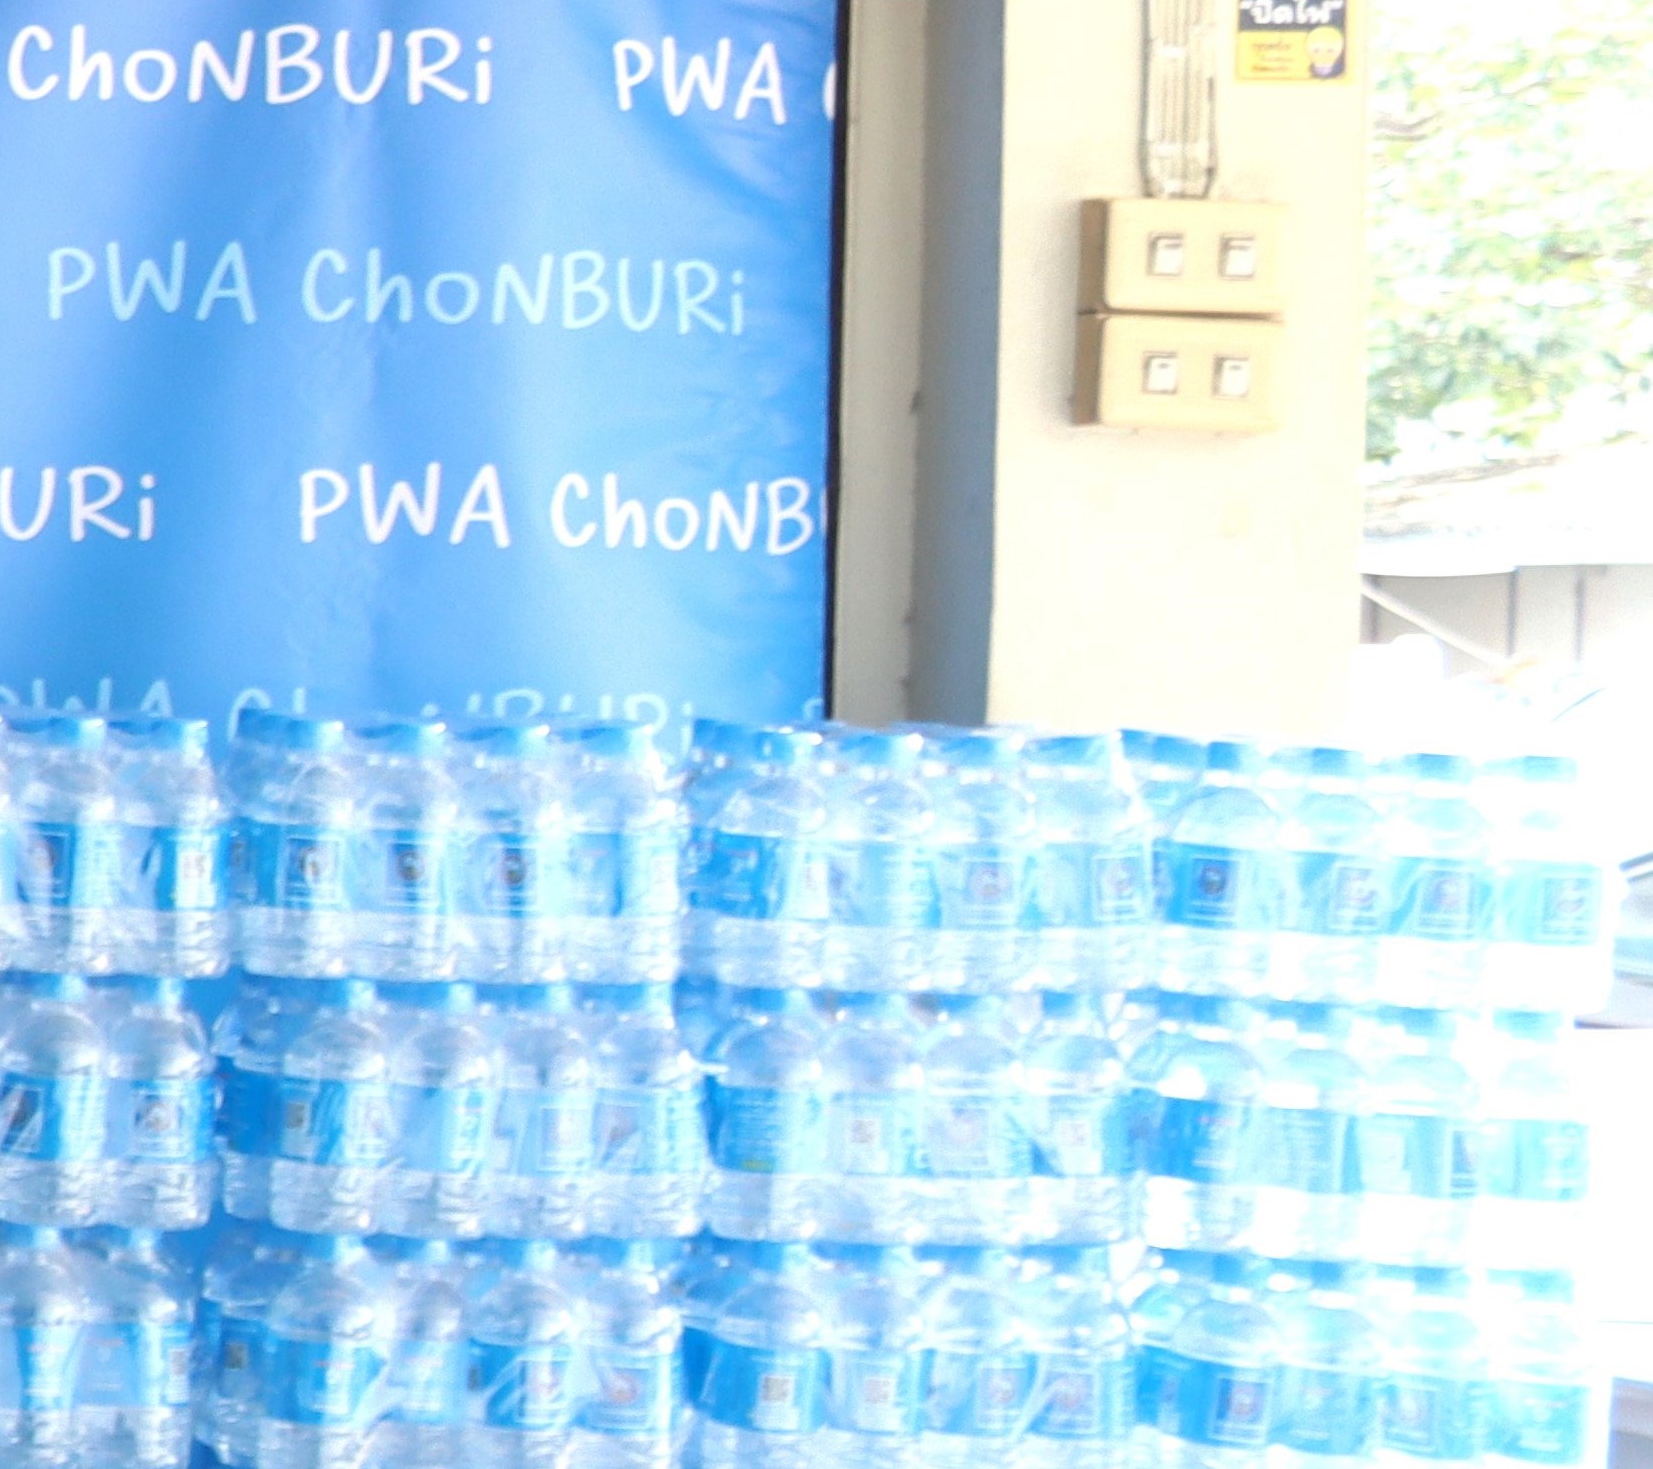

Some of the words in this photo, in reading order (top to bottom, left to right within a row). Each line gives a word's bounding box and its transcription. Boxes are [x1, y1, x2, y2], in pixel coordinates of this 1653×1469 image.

[613, 36, 786, 124] PWA
[49, 240, 257, 324] PWA
[300, 462, 511, 548] PWA
